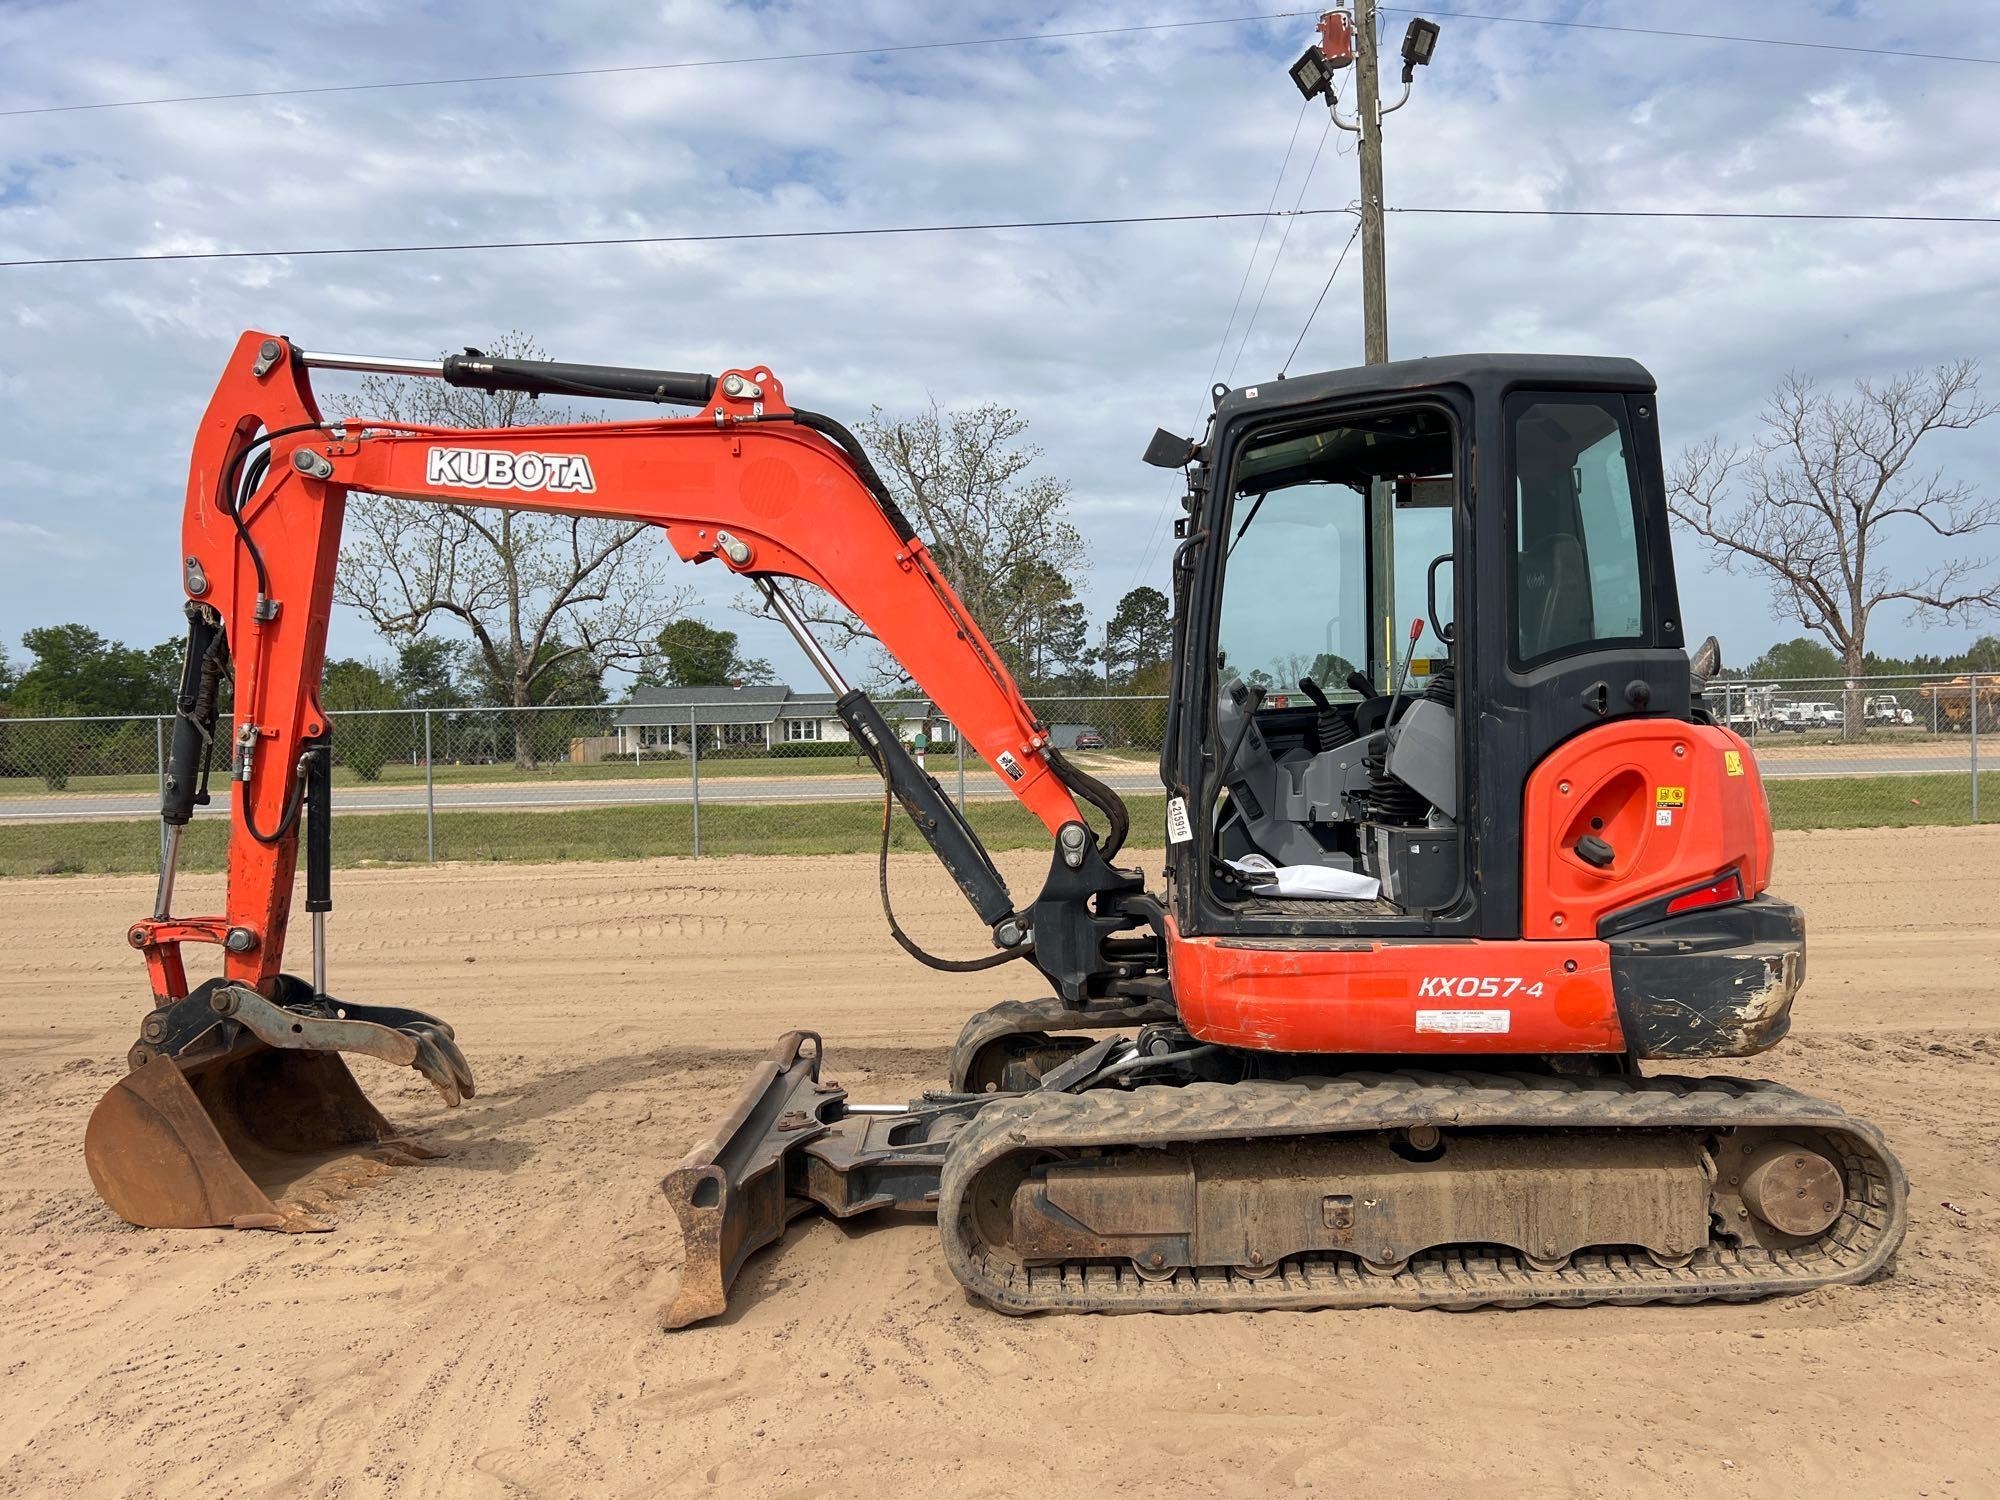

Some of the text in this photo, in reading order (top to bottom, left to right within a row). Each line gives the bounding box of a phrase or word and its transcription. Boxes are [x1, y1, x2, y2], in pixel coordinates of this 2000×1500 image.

[429, 448, 594, 491] KUBOTA
[1172, 806, 1187, 836] 215916
[1417, 976, 1544, 998] KX057-4
